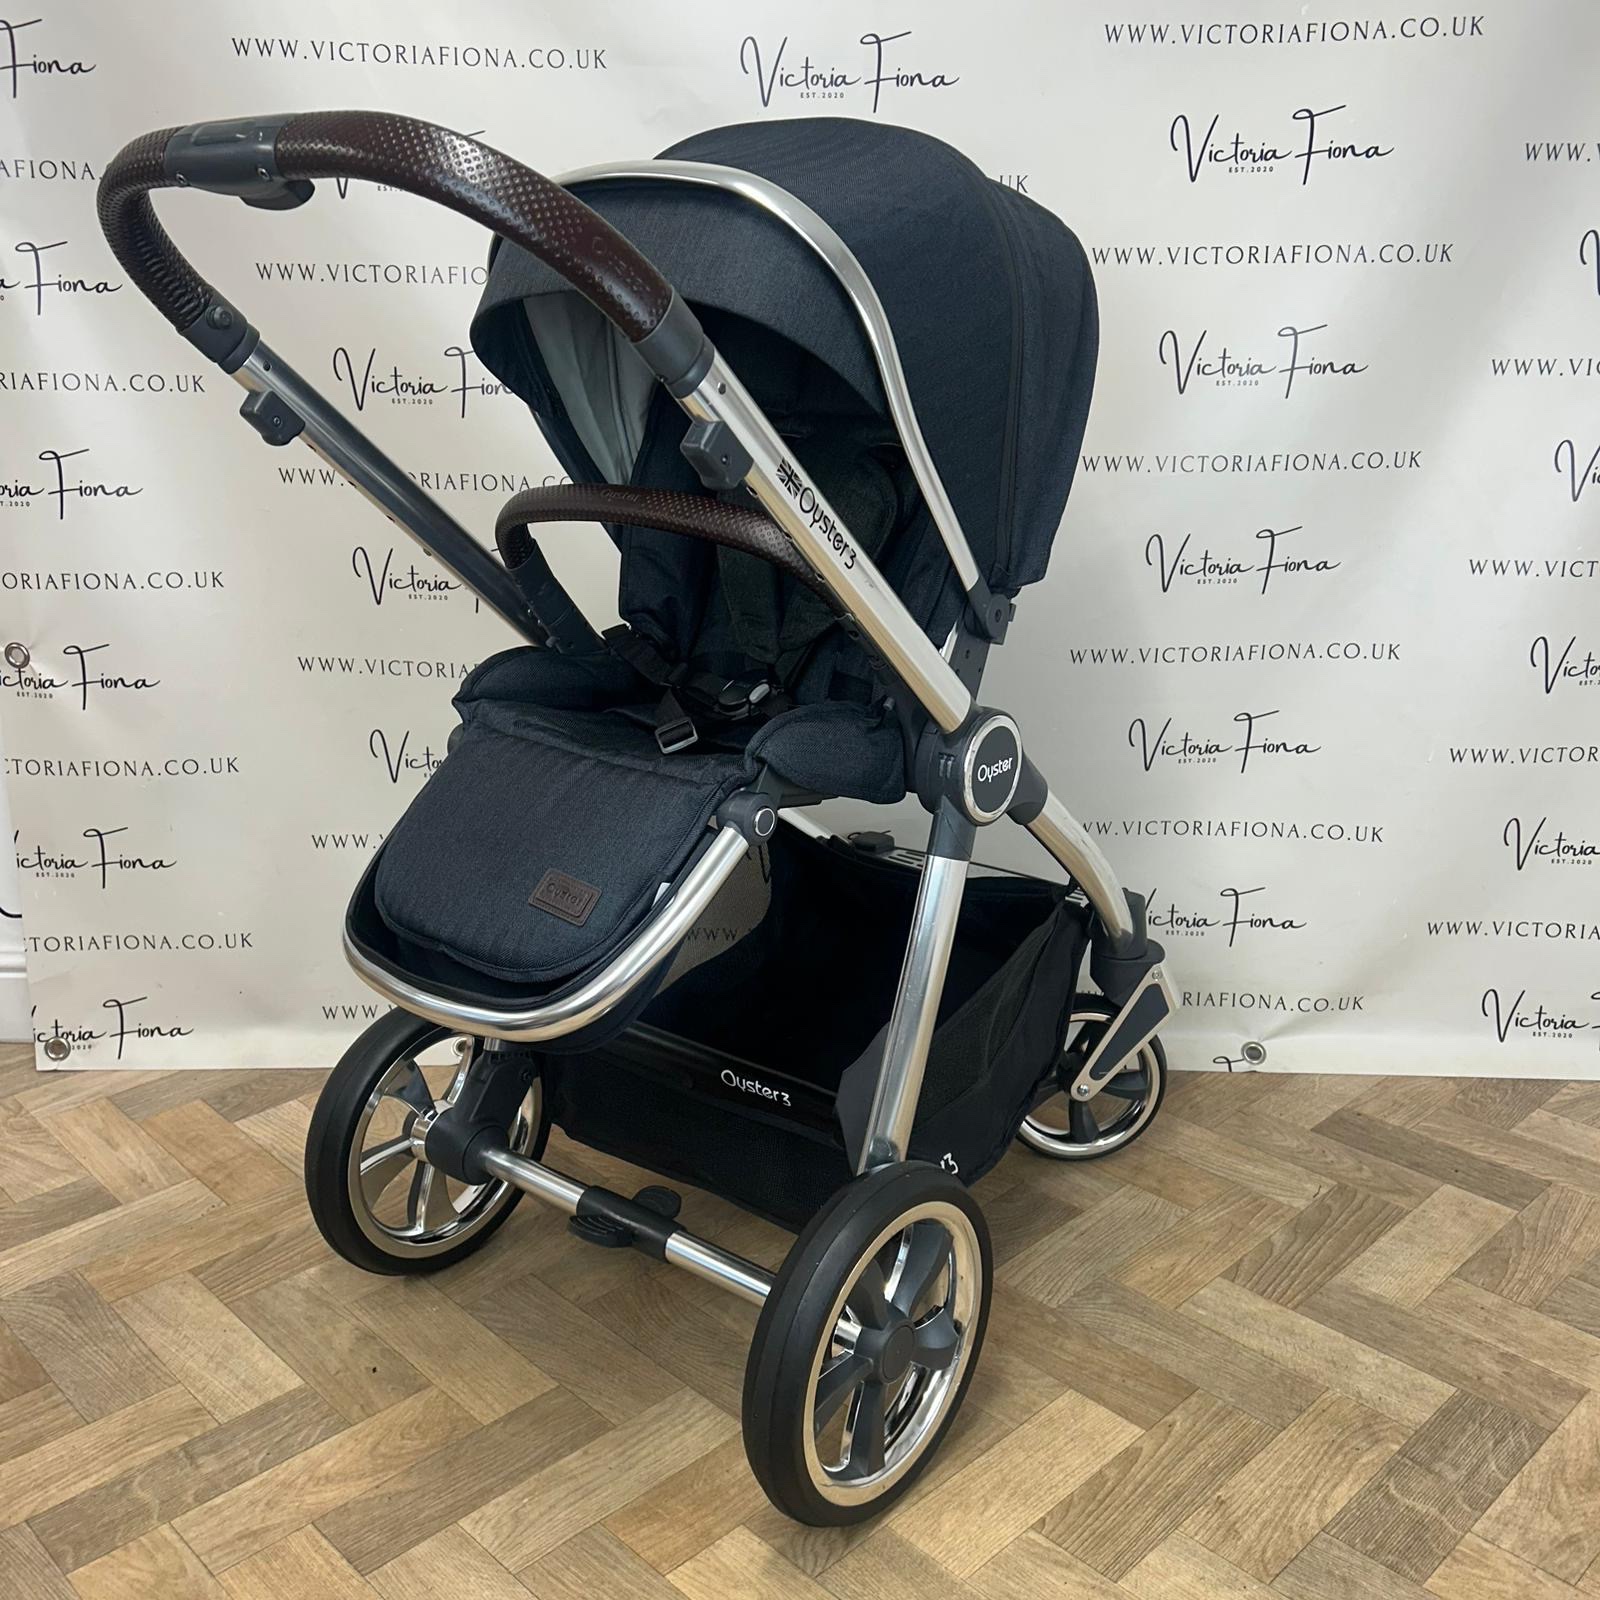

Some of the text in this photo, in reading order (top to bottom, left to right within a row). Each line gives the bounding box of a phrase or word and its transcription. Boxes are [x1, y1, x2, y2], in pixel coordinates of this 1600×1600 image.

[231, 37, 608, 69] WWW.VICTORIAFIONA.CO.UK
[1104, 16, 1485, 44] WWW.VICTORIAFIONA.CO.UK
[0, 19, 95, 98] Fiona
[740, 31, 960, 113] Victoria Fiona
[1170, 105, 1394, 185] Victoria Fiona
[1525, 143, 1600, 161] WWW.
[15, 240, 123, 316] Fiona
[1092, 244, 1453, 265] WWW.VICTORIAFIONA.CO.UK
[333, 347, 448, 411] Victoria
[1159, 324, 1368, 399] Victoria Fiona
[1491, 358, 1600, 376] WWW.VI
[39, 448, 143, 519] Fiona
[1082, 451, 1422, 473] WWW.VICTORIAFIONA.CO.UK
[2, 571, 224, 590] ORIAFIONA.CO.UK
[352, 546, 462, 605] Victoria
[1146, 526, 1342, 595] Victoria Fiona
[63, 644, 160, 710] Fiona
[1070, 643, 1400, 664] WWW.VICTORIAFIONA.CO.UK
[5, 757, 240, 776] TORIAFIONA.CO.UK
[370, 729, 442, 783] Victo
[1128, 710, 1322, 773] Victoria Fiona
[978, 757, 1013, 783] Oyster
[14, 827, 177, 889] ictoria Fiona
[1503, 817, 1600, 871] Victoria
[24, 933, 253, 952] TORIAFIONA.CO.UK
[1220, 887, 1307, 947] Fiona
[31, 997, 194, 1060] ictoria Fiona
[1482, 989, 1590, 1042] Victoria
